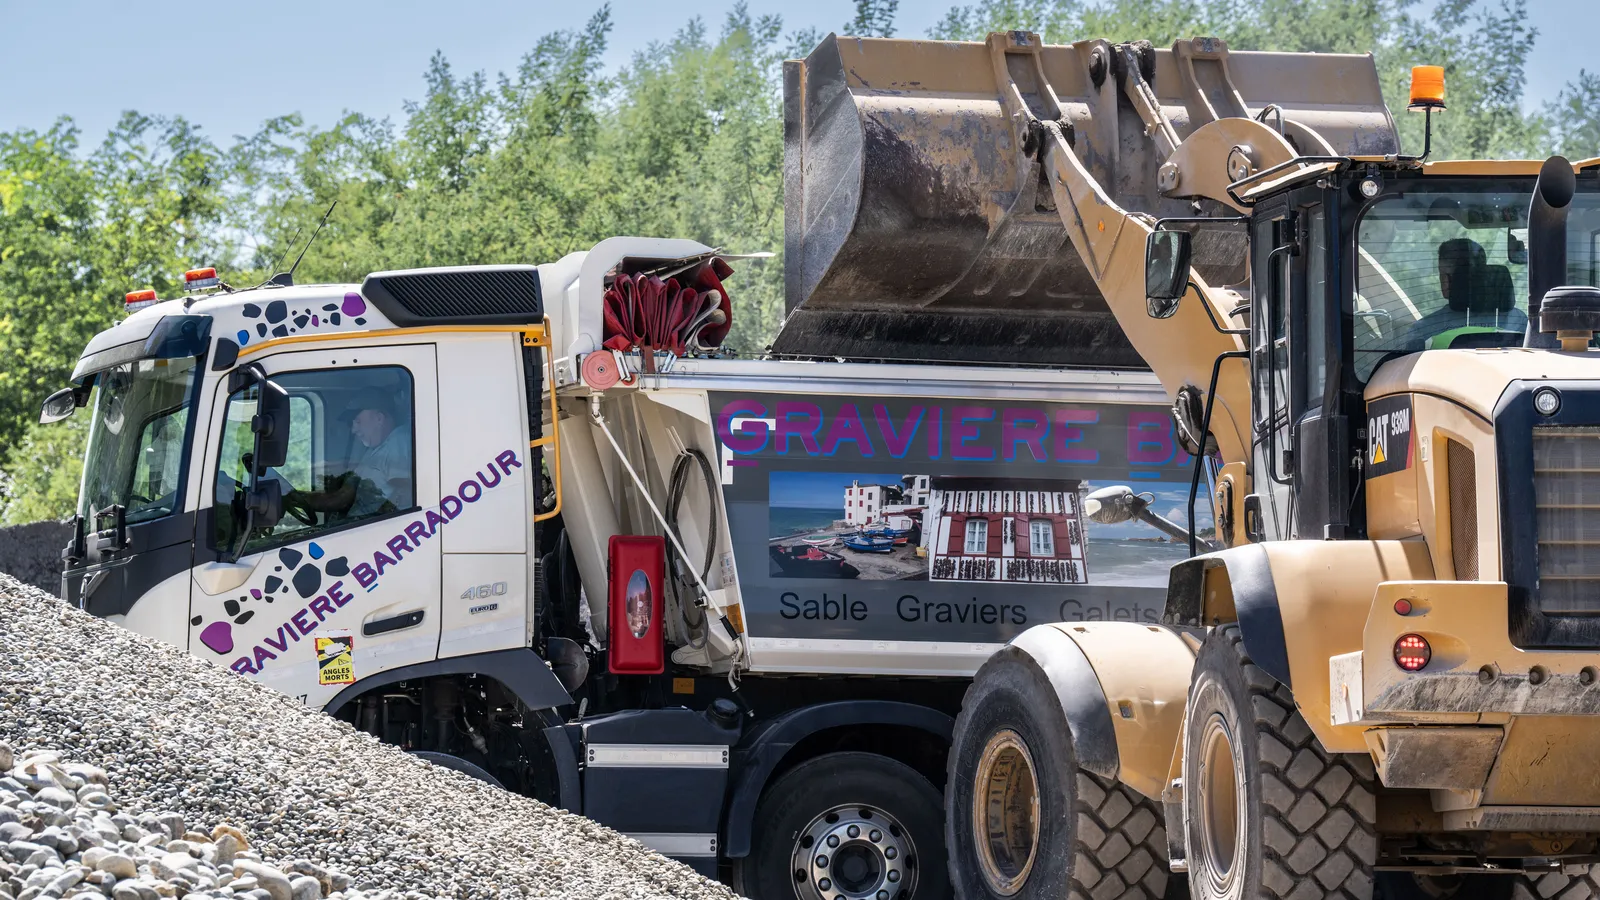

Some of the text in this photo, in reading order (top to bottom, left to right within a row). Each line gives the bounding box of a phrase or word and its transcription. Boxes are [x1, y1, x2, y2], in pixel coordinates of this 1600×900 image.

[716, 399, 1100, 464] GRAVIERE
[1368, 414, 1389, 465] CAT
[1391, 407, 1410, 436] 938M
[229, 449, 523, 675] RAVIERE BARRADOUR
[460, 581, 508, 600] 460
[470, 605, 489, 613] EURO
[779, 591, 1159, 626] Sable Graviers Galets
[323, 667, 350, 675] ANGLES
[325, 673, 350, 681] MORTS
